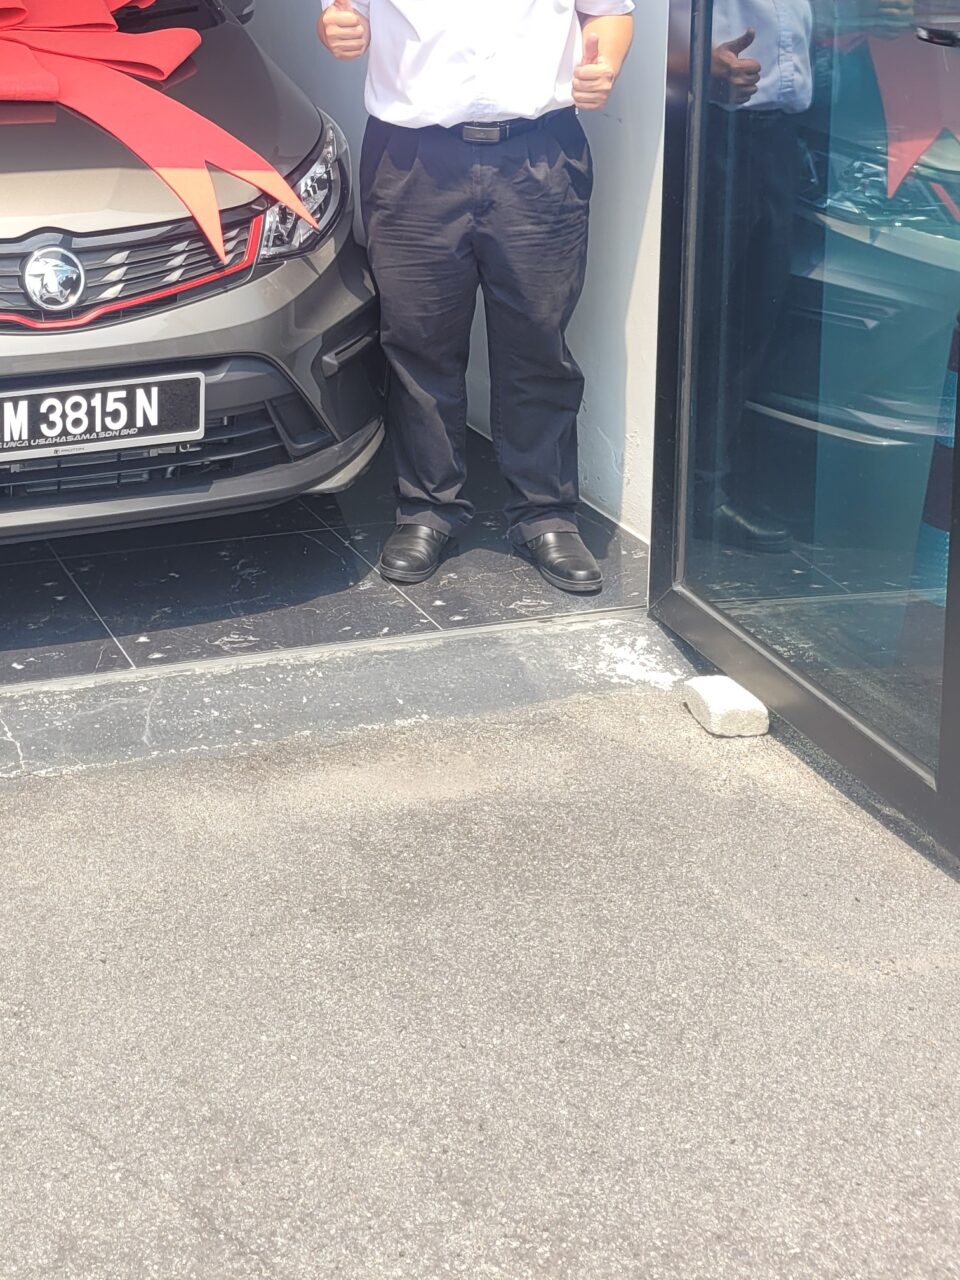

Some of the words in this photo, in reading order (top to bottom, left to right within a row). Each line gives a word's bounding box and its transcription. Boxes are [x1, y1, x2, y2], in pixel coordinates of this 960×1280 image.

[40, 390, 127, 438] 3815
[135, 386, 159, 428] N
[31, 431, 98, 446] USAHASAMA
